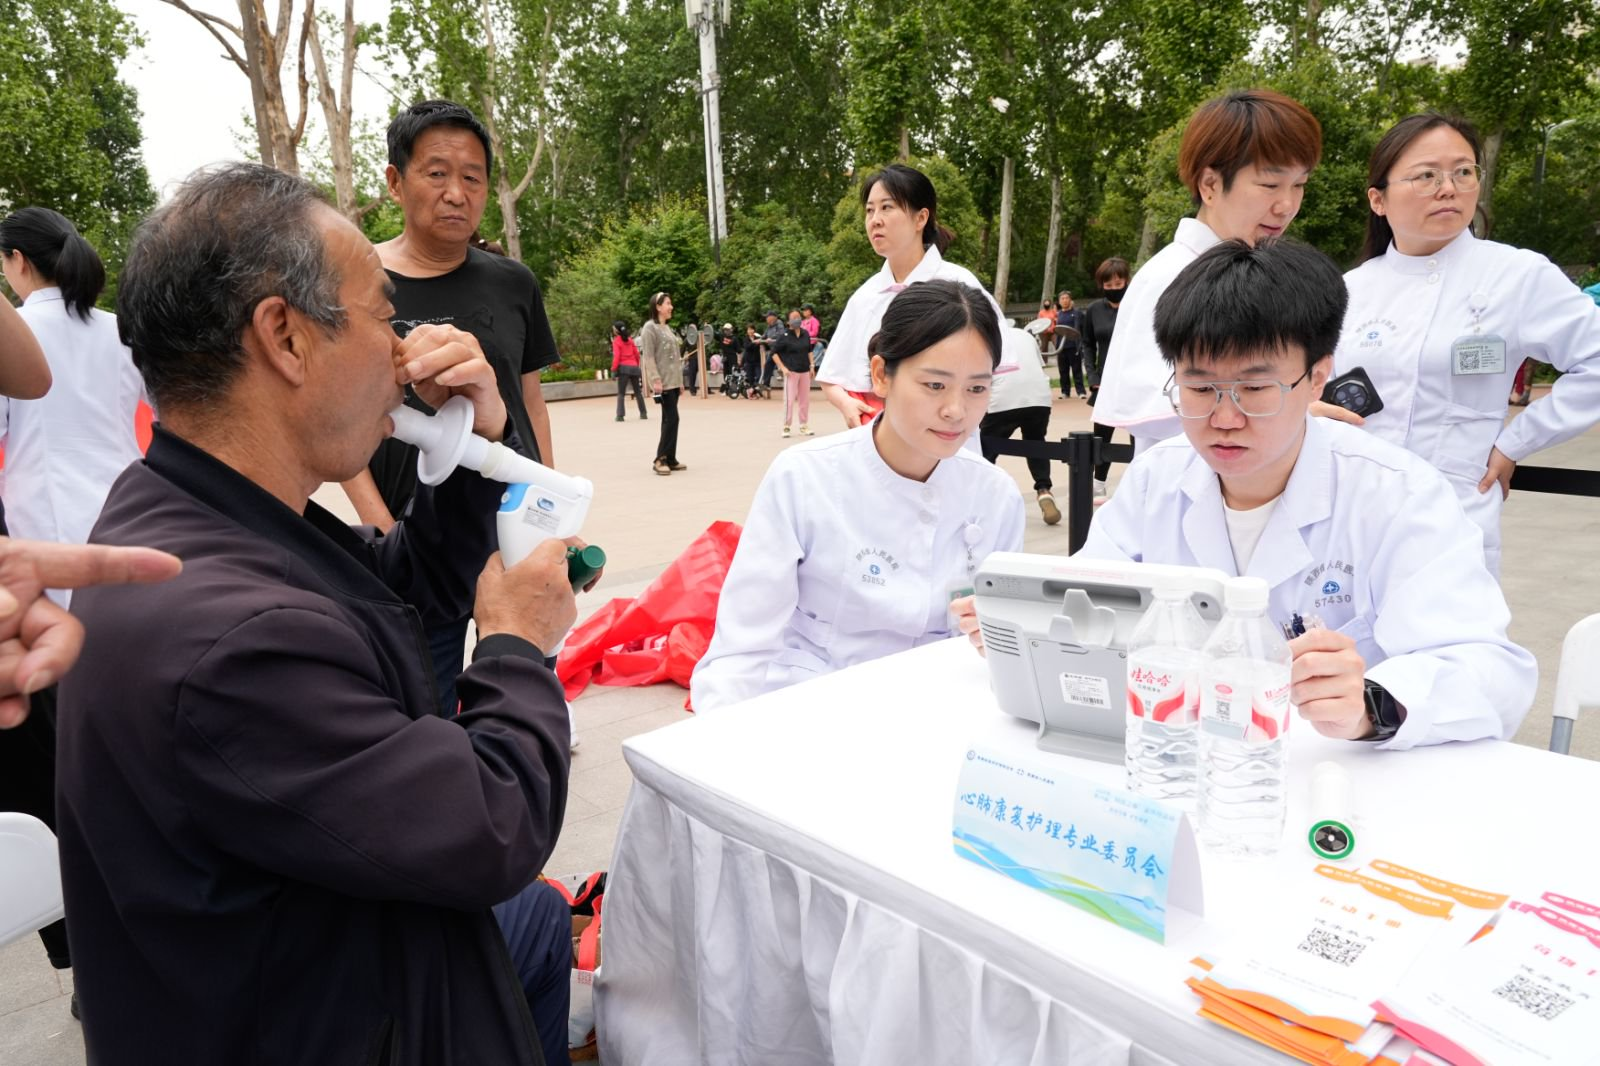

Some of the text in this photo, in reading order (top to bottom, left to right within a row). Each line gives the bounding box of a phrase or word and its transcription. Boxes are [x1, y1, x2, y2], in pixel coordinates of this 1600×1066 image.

[1314, 594, 1352, 608] 57430
[1130, 667, 1171, 687] 娃哈哈
[960, 792, 1164, 880] 心肺康复护理专业委员会
